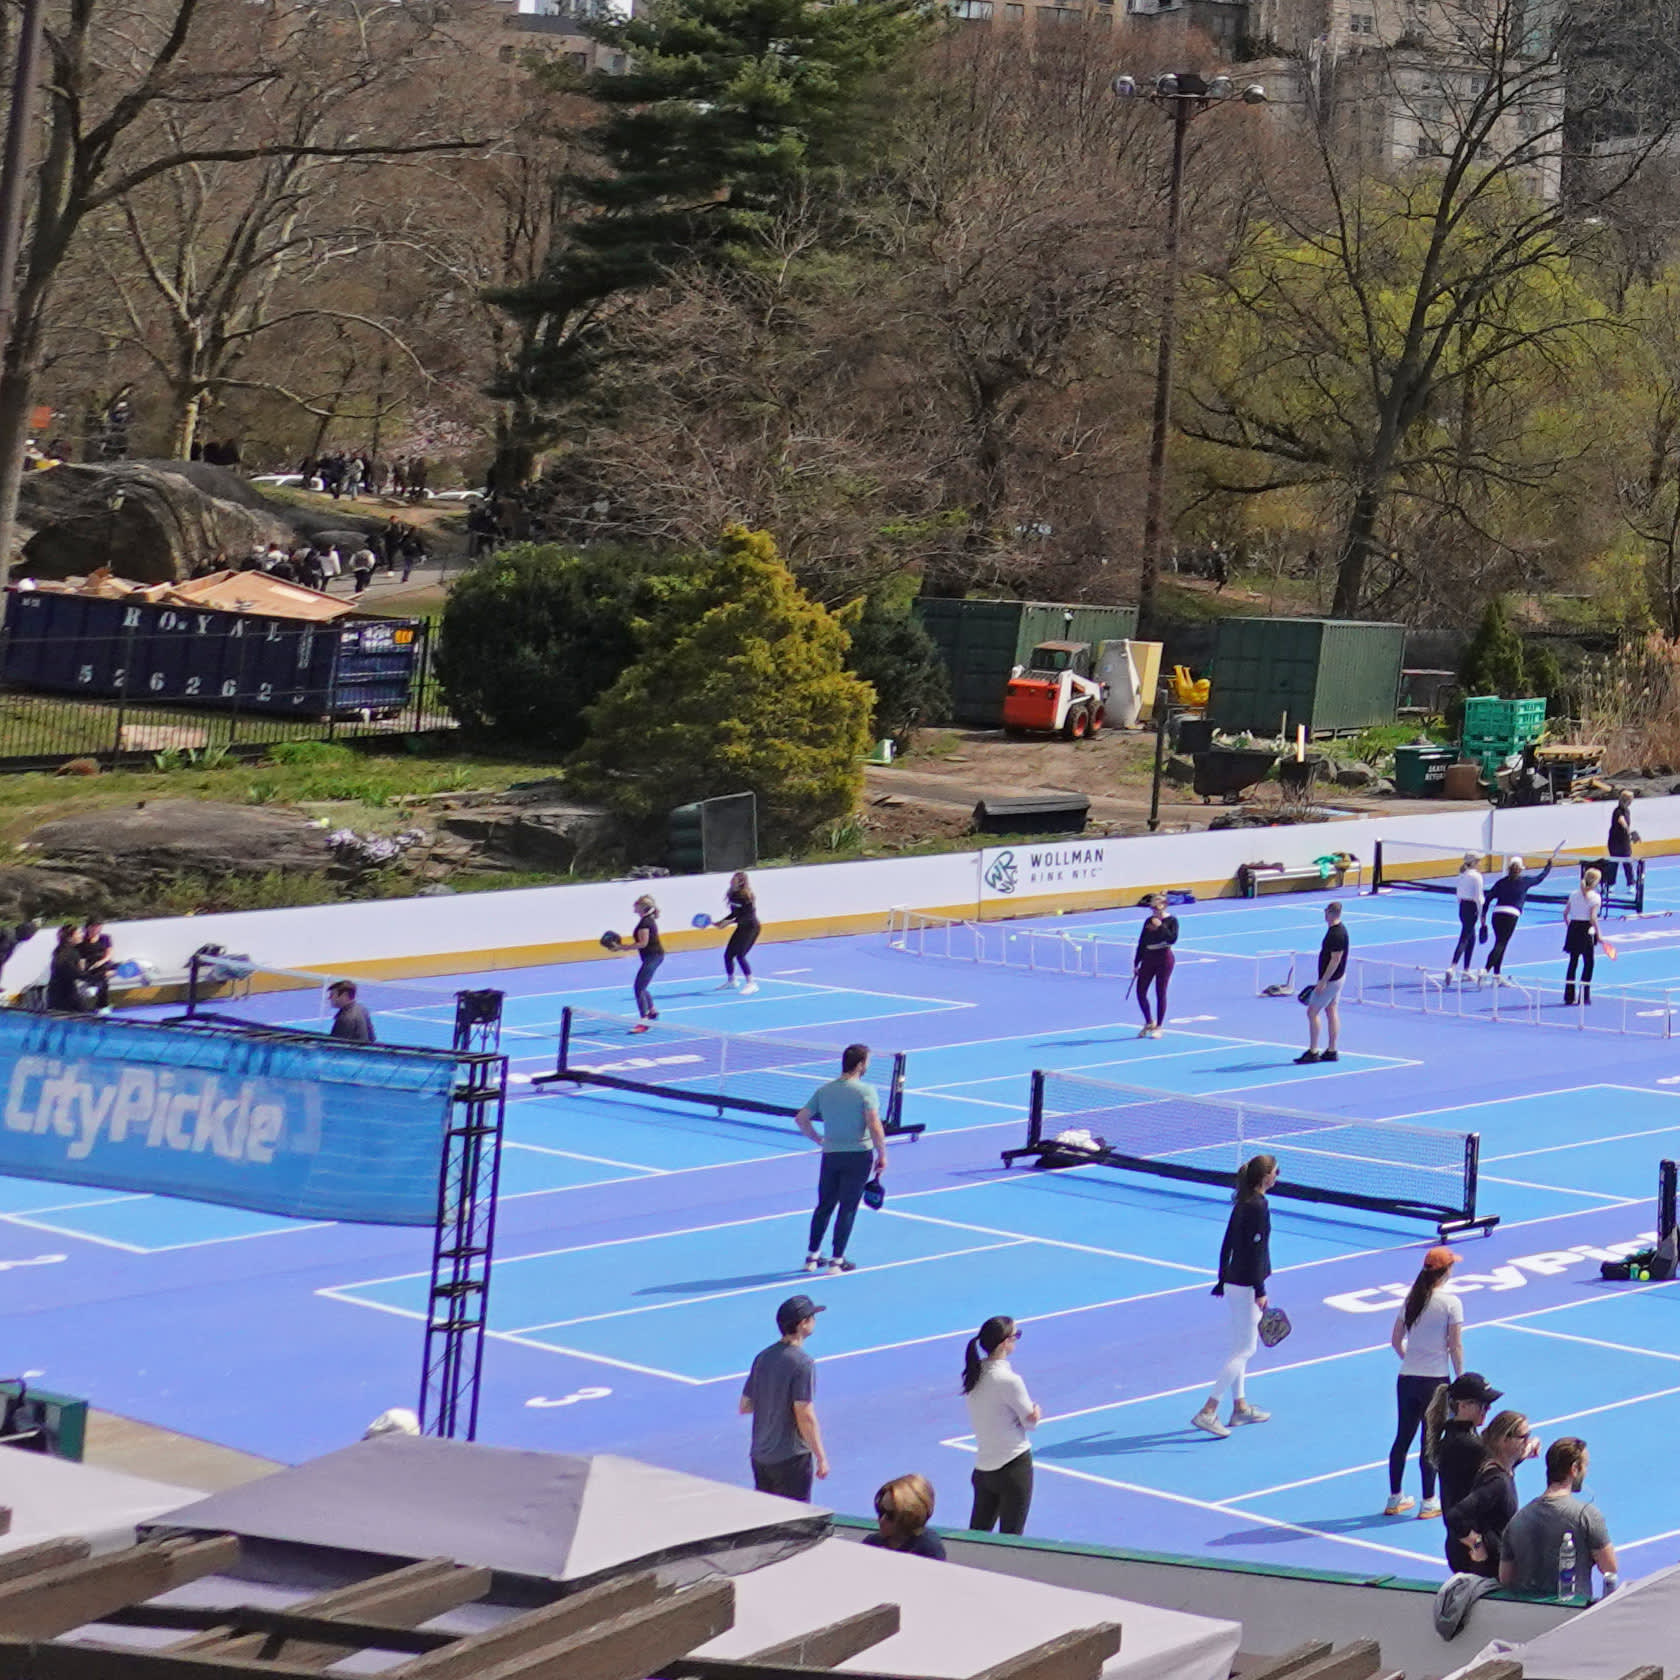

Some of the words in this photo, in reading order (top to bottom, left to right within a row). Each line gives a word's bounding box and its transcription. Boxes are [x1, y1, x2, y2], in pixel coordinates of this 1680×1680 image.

[122, 606, 283, 642] ROYAL
[1030, 848, 1104, 867] WOLLMAN
[1030, 870, 1063, 883] RINK
[1072, 867, 1098, 880] NYC
[4, 1055, 284, 1164] CityPickle
